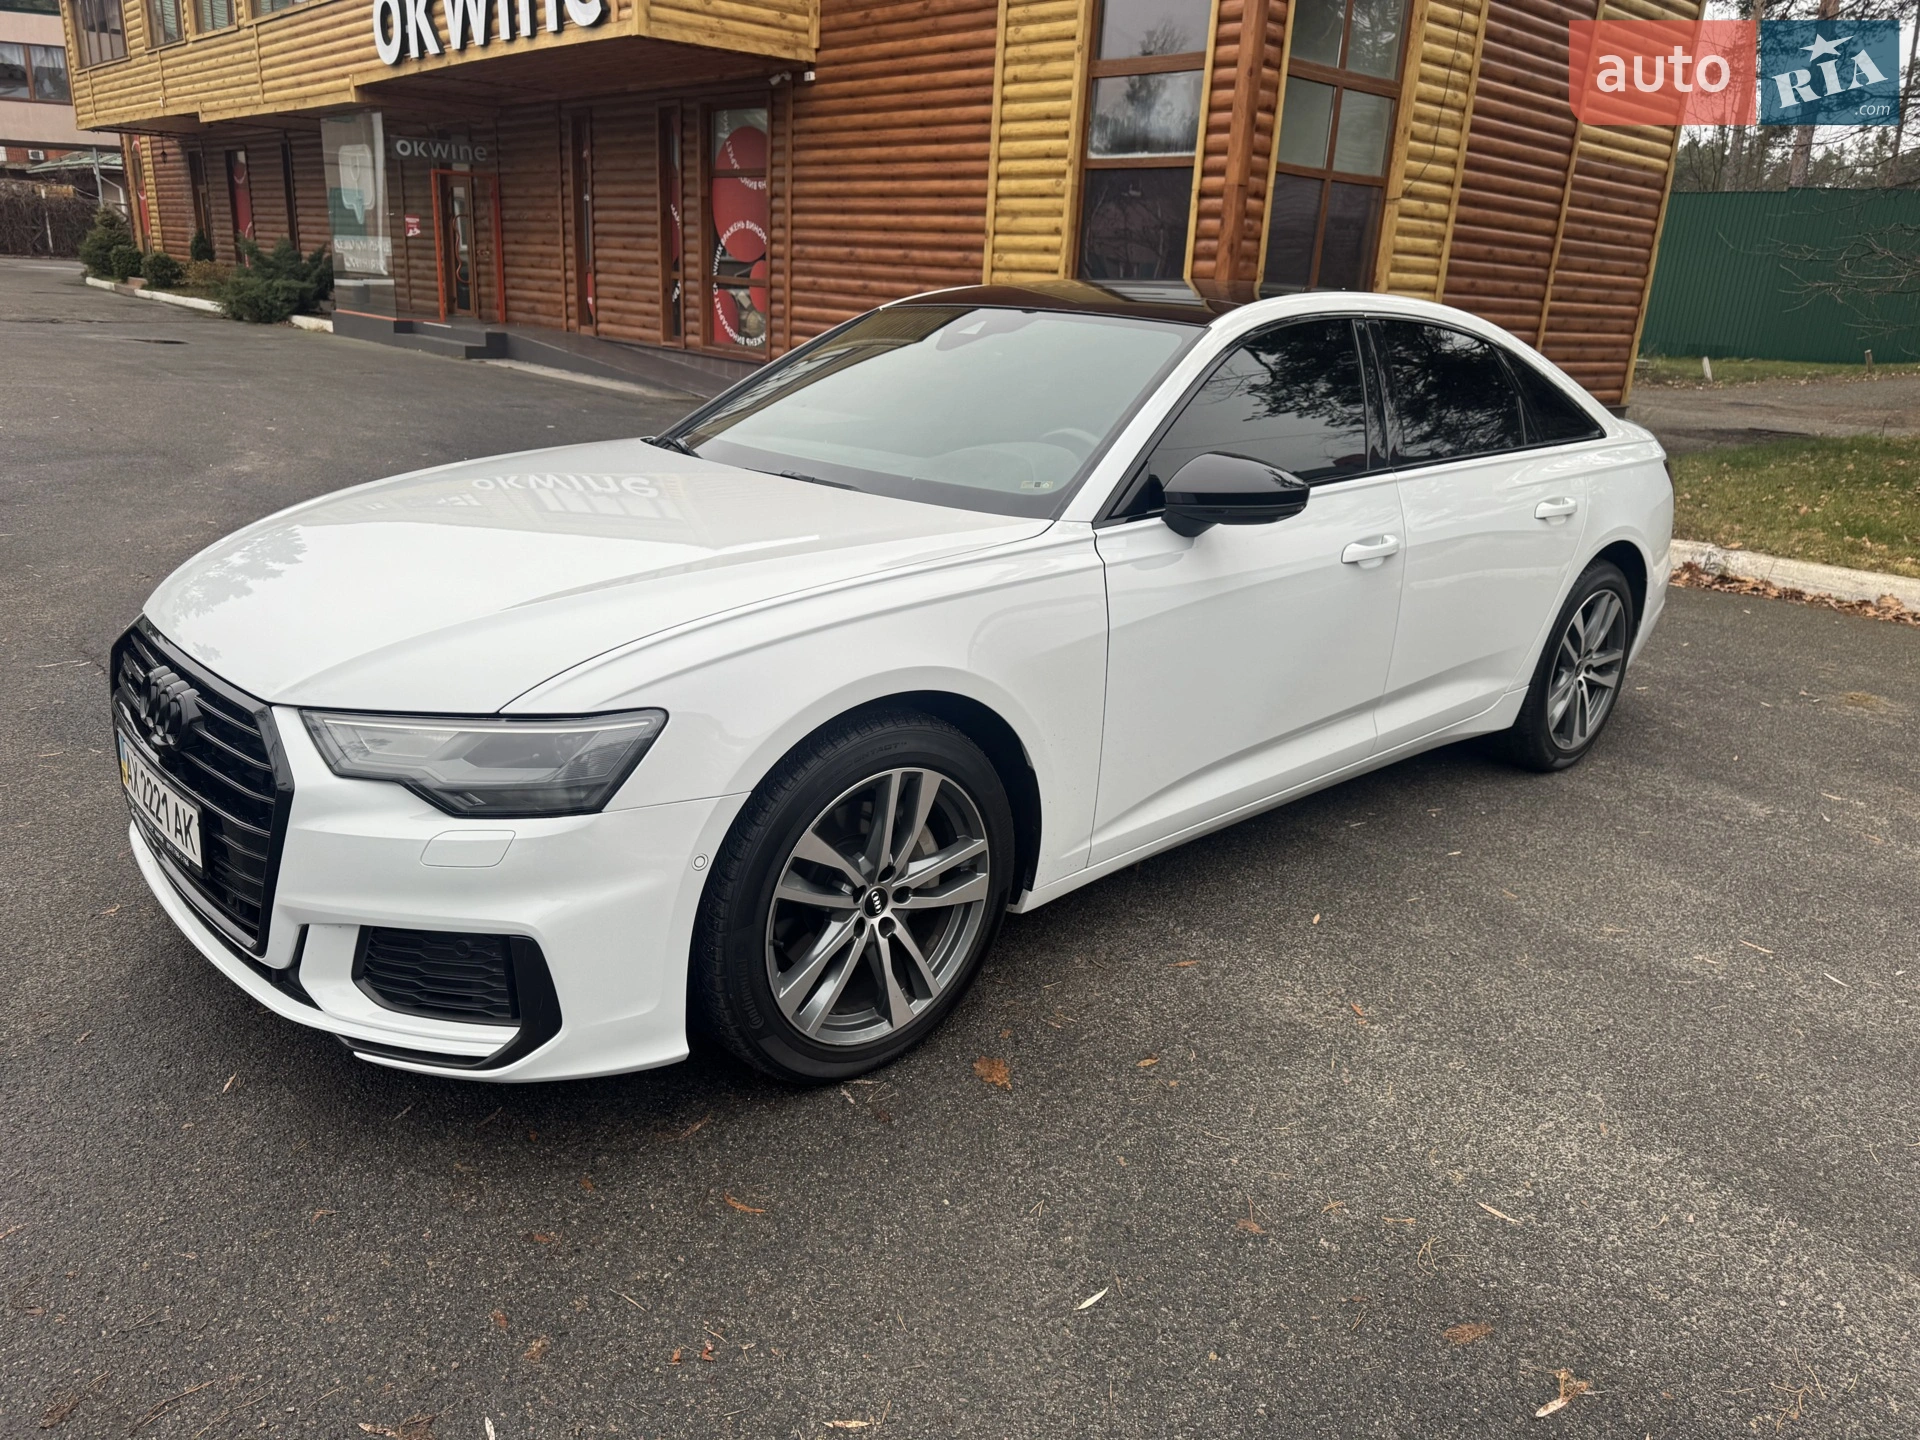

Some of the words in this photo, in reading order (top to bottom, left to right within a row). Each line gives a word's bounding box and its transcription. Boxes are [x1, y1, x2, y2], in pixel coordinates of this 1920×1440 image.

[125, 750, 140, 799] AX
[140, 769, 170, 833] 2221
[174, 801, 198, 856] AK
